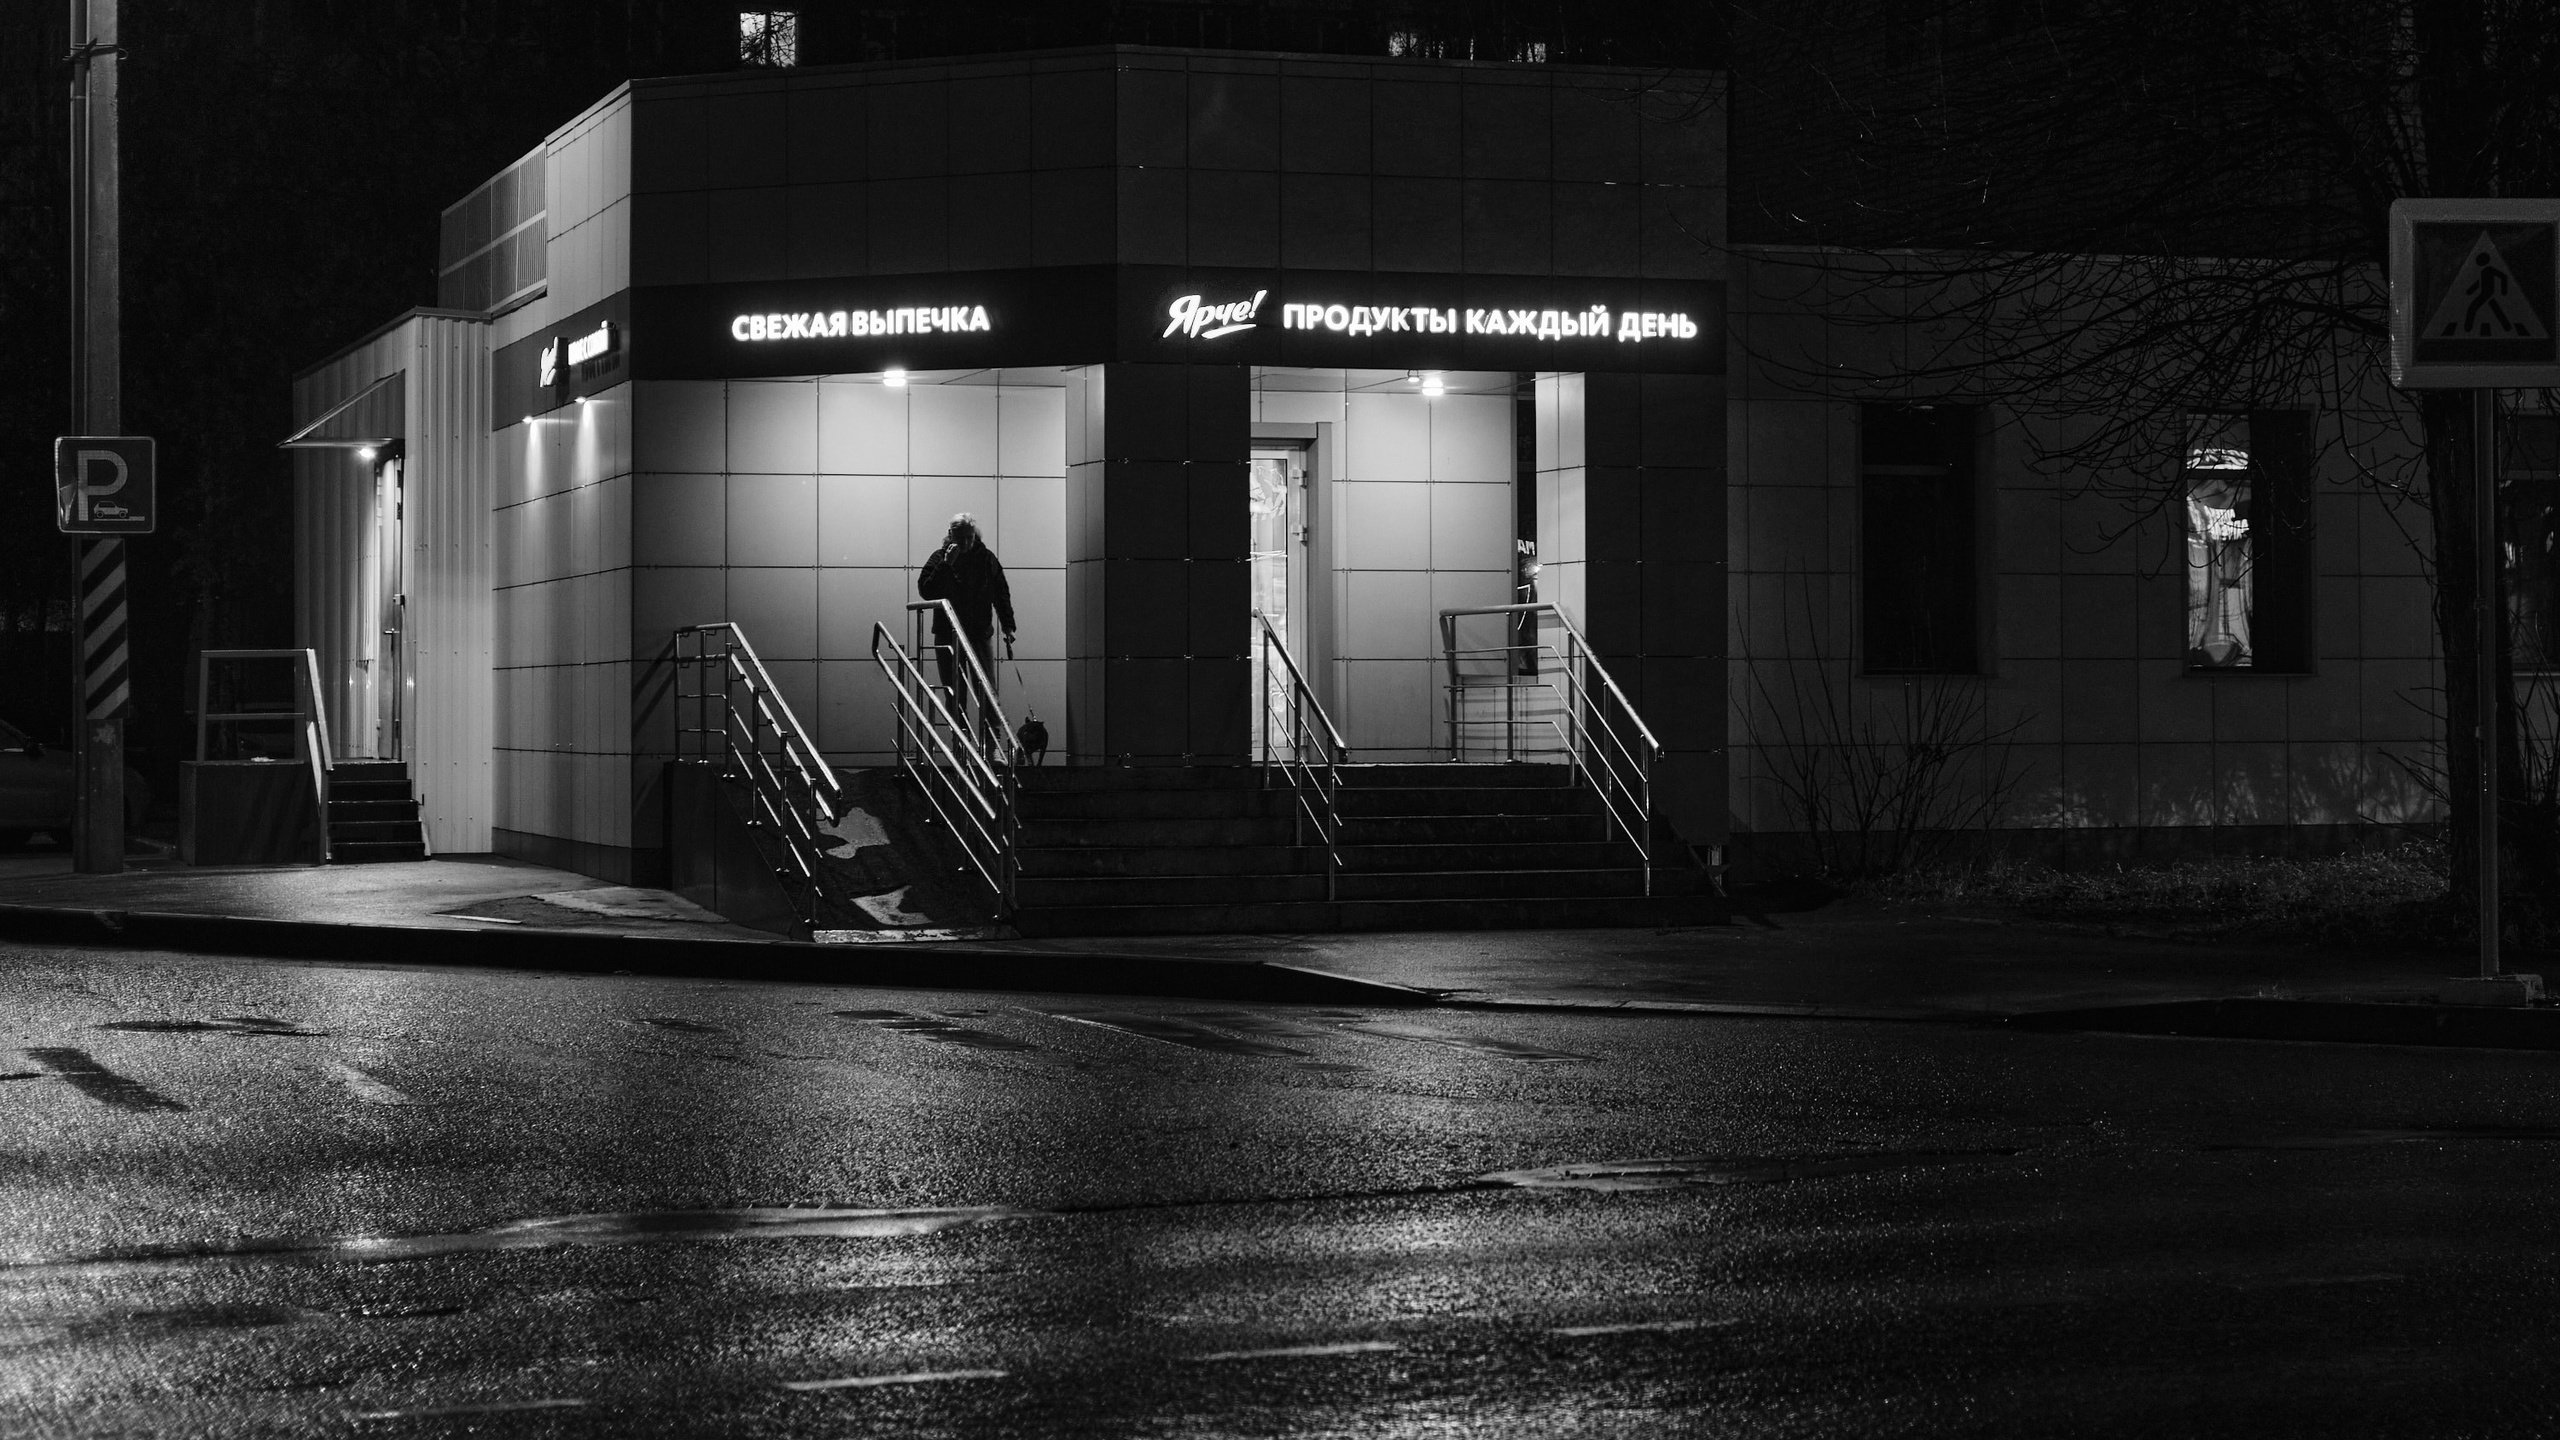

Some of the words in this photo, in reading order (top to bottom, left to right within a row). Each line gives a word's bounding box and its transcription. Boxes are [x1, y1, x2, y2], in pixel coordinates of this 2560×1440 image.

[731, 311, 847, 341] СВЕЖАЯ
[851, 305, 990, 336] ВЫПЕЧКА
[1163, 290, 1267, 340] Ярче!
[1283, 303, 1457, 336] ПРОДУКТЫ
[1465, 305, 1611, 341] КАЖДЫЙ
[1617, 312, 1697, 342] ДЕНЬ
[78, 450, 128, 521] P
